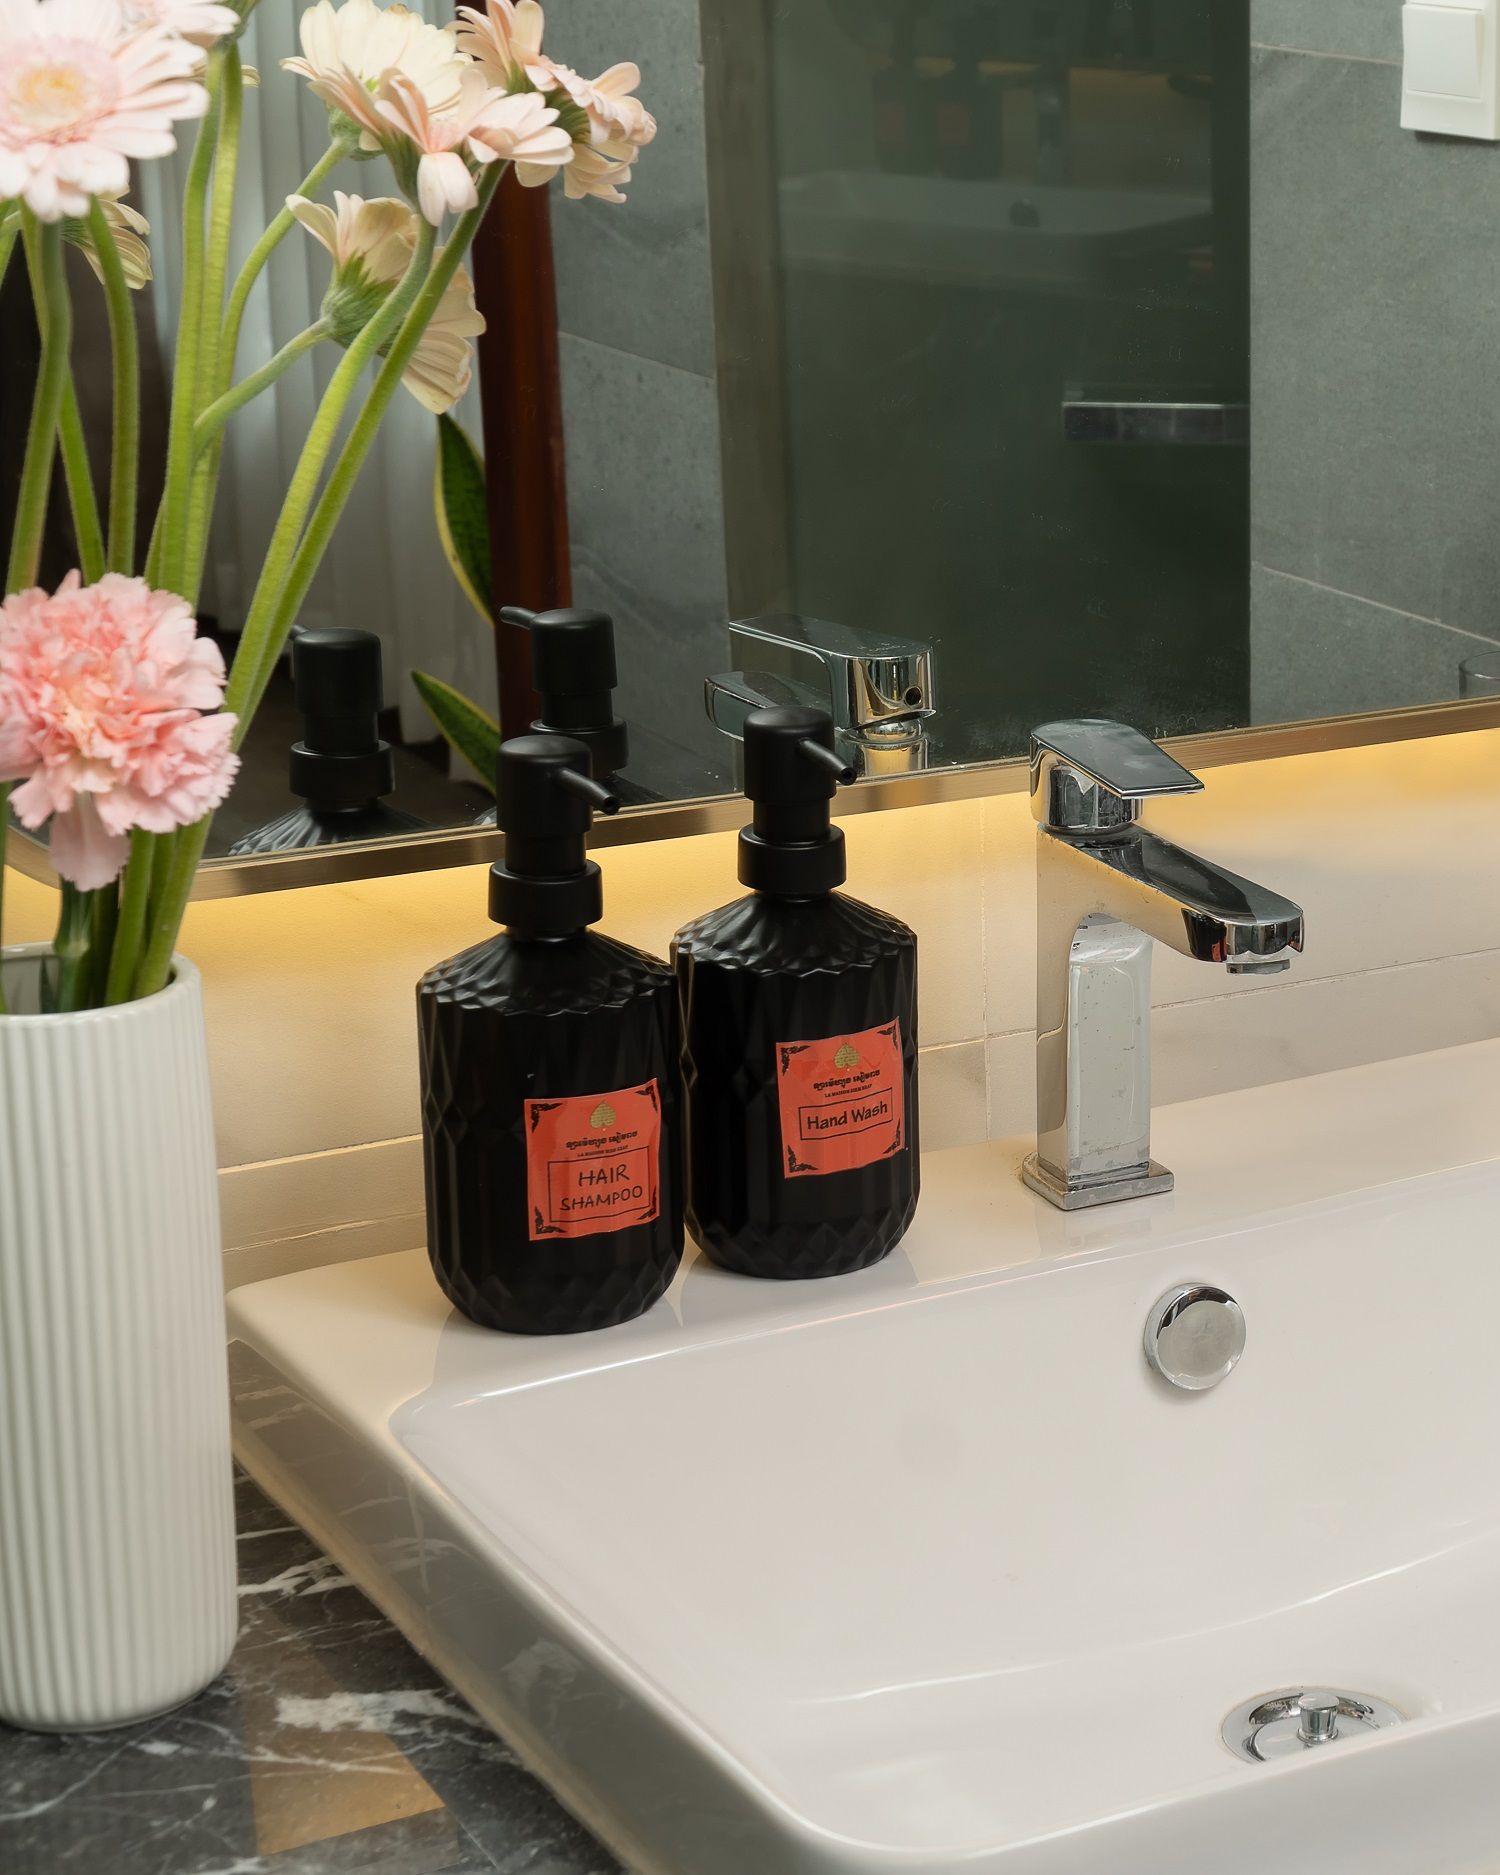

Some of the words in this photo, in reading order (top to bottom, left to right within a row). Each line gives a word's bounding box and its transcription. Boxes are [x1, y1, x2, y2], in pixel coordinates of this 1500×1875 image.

[807, 1111, 848, 1130] Hand
[851, 1101, 888, 1124] Wash
[578, 1163, 630, 1187] HAIR
[560, 1185, 643, 1211] SHAMPOO
